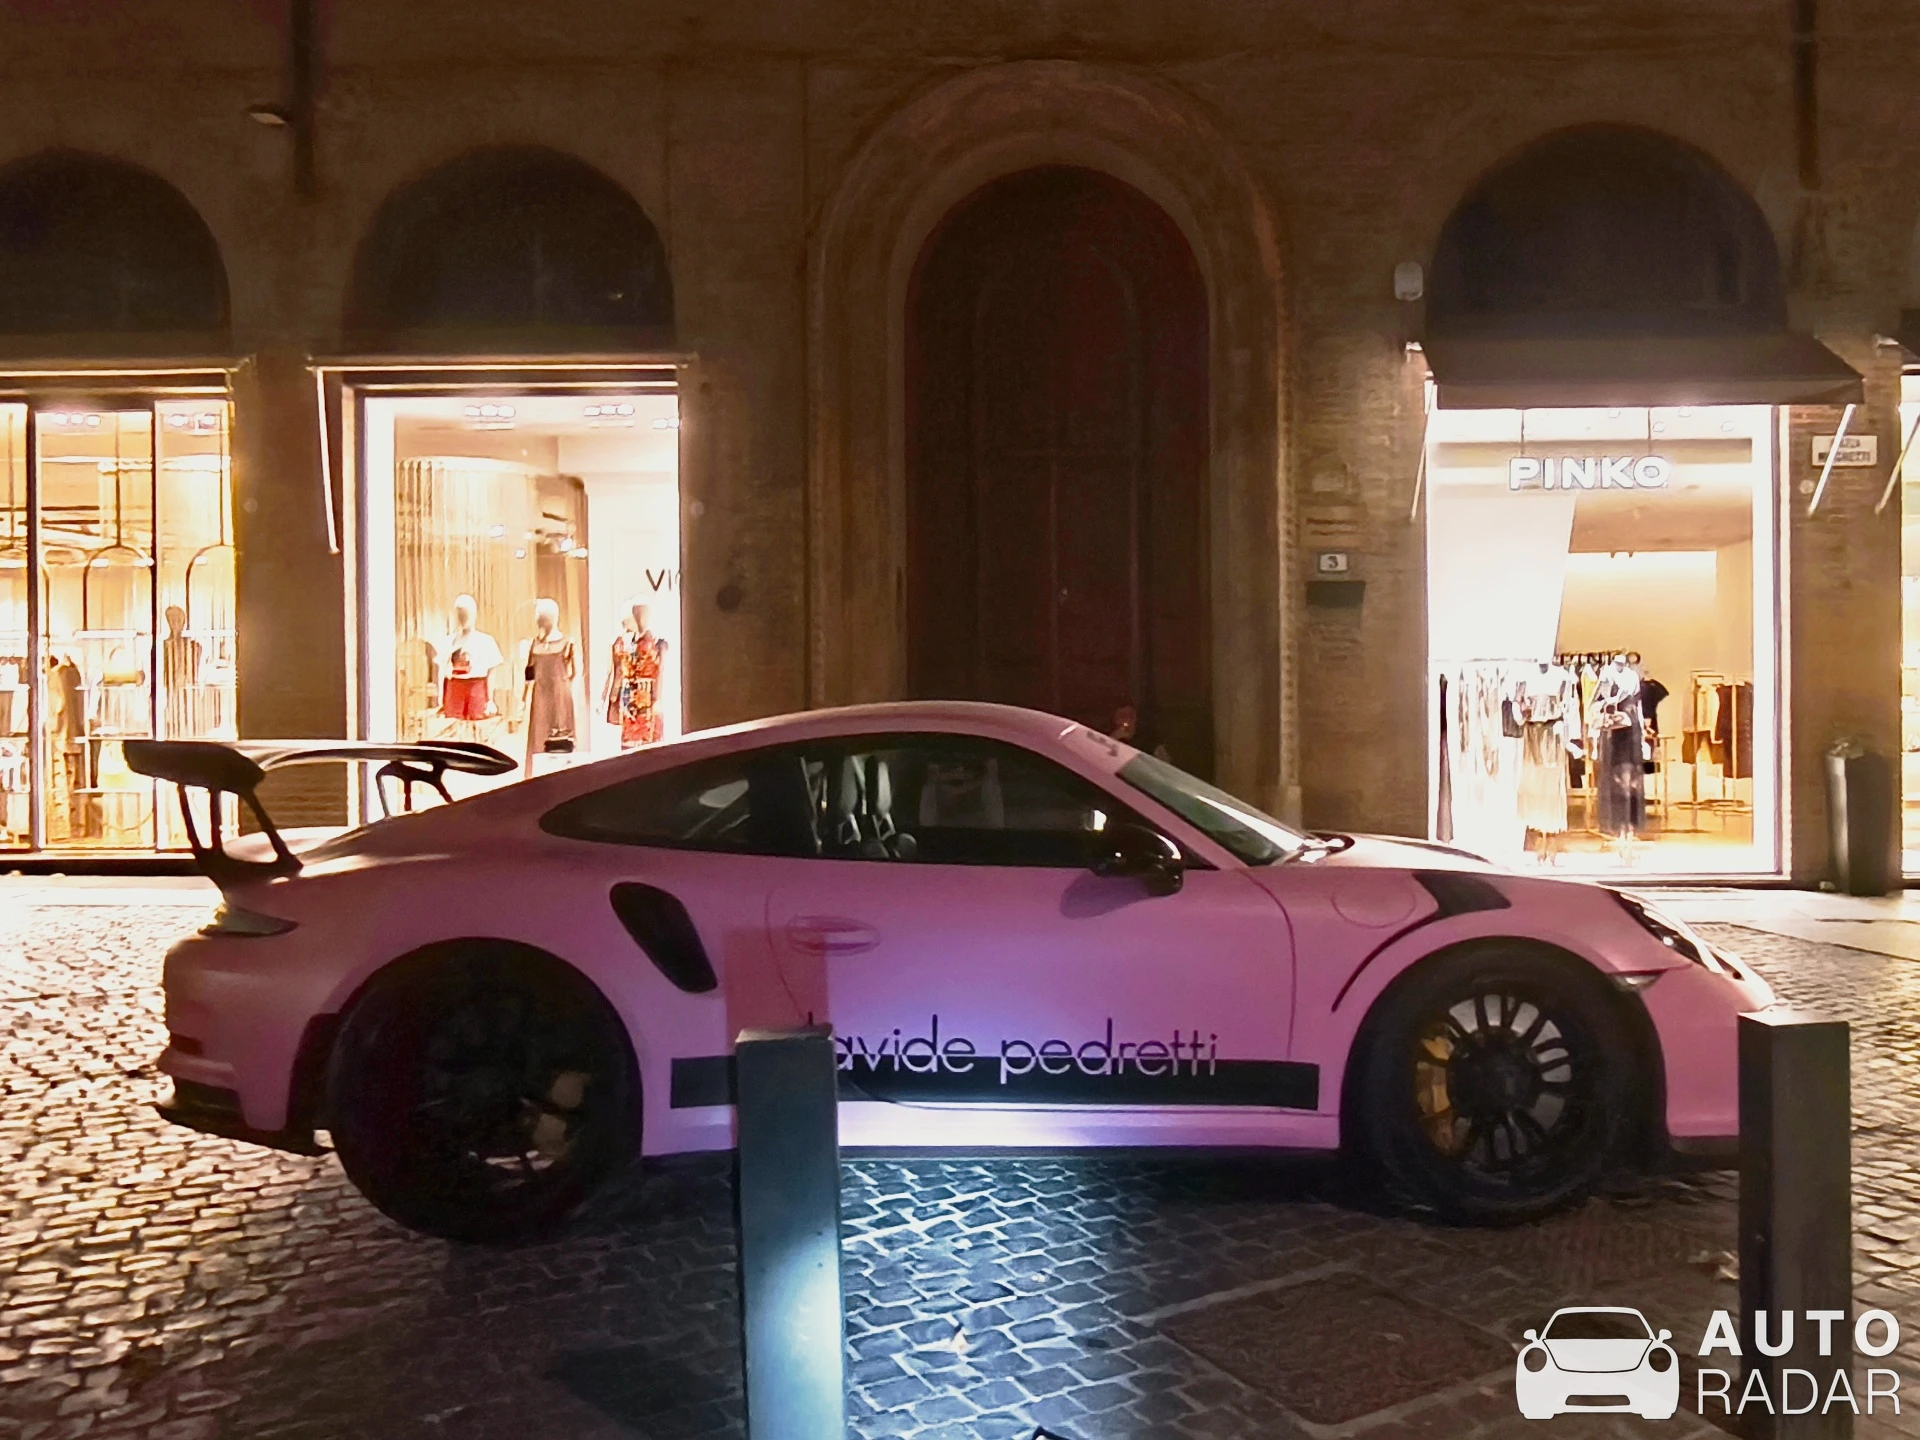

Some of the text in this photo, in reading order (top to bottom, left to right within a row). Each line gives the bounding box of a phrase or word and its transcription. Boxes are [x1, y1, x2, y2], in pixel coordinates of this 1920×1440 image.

[1509, 455, 1671, 490] PINKO
[808, 1011, 1218, 1085] avide pedretti
